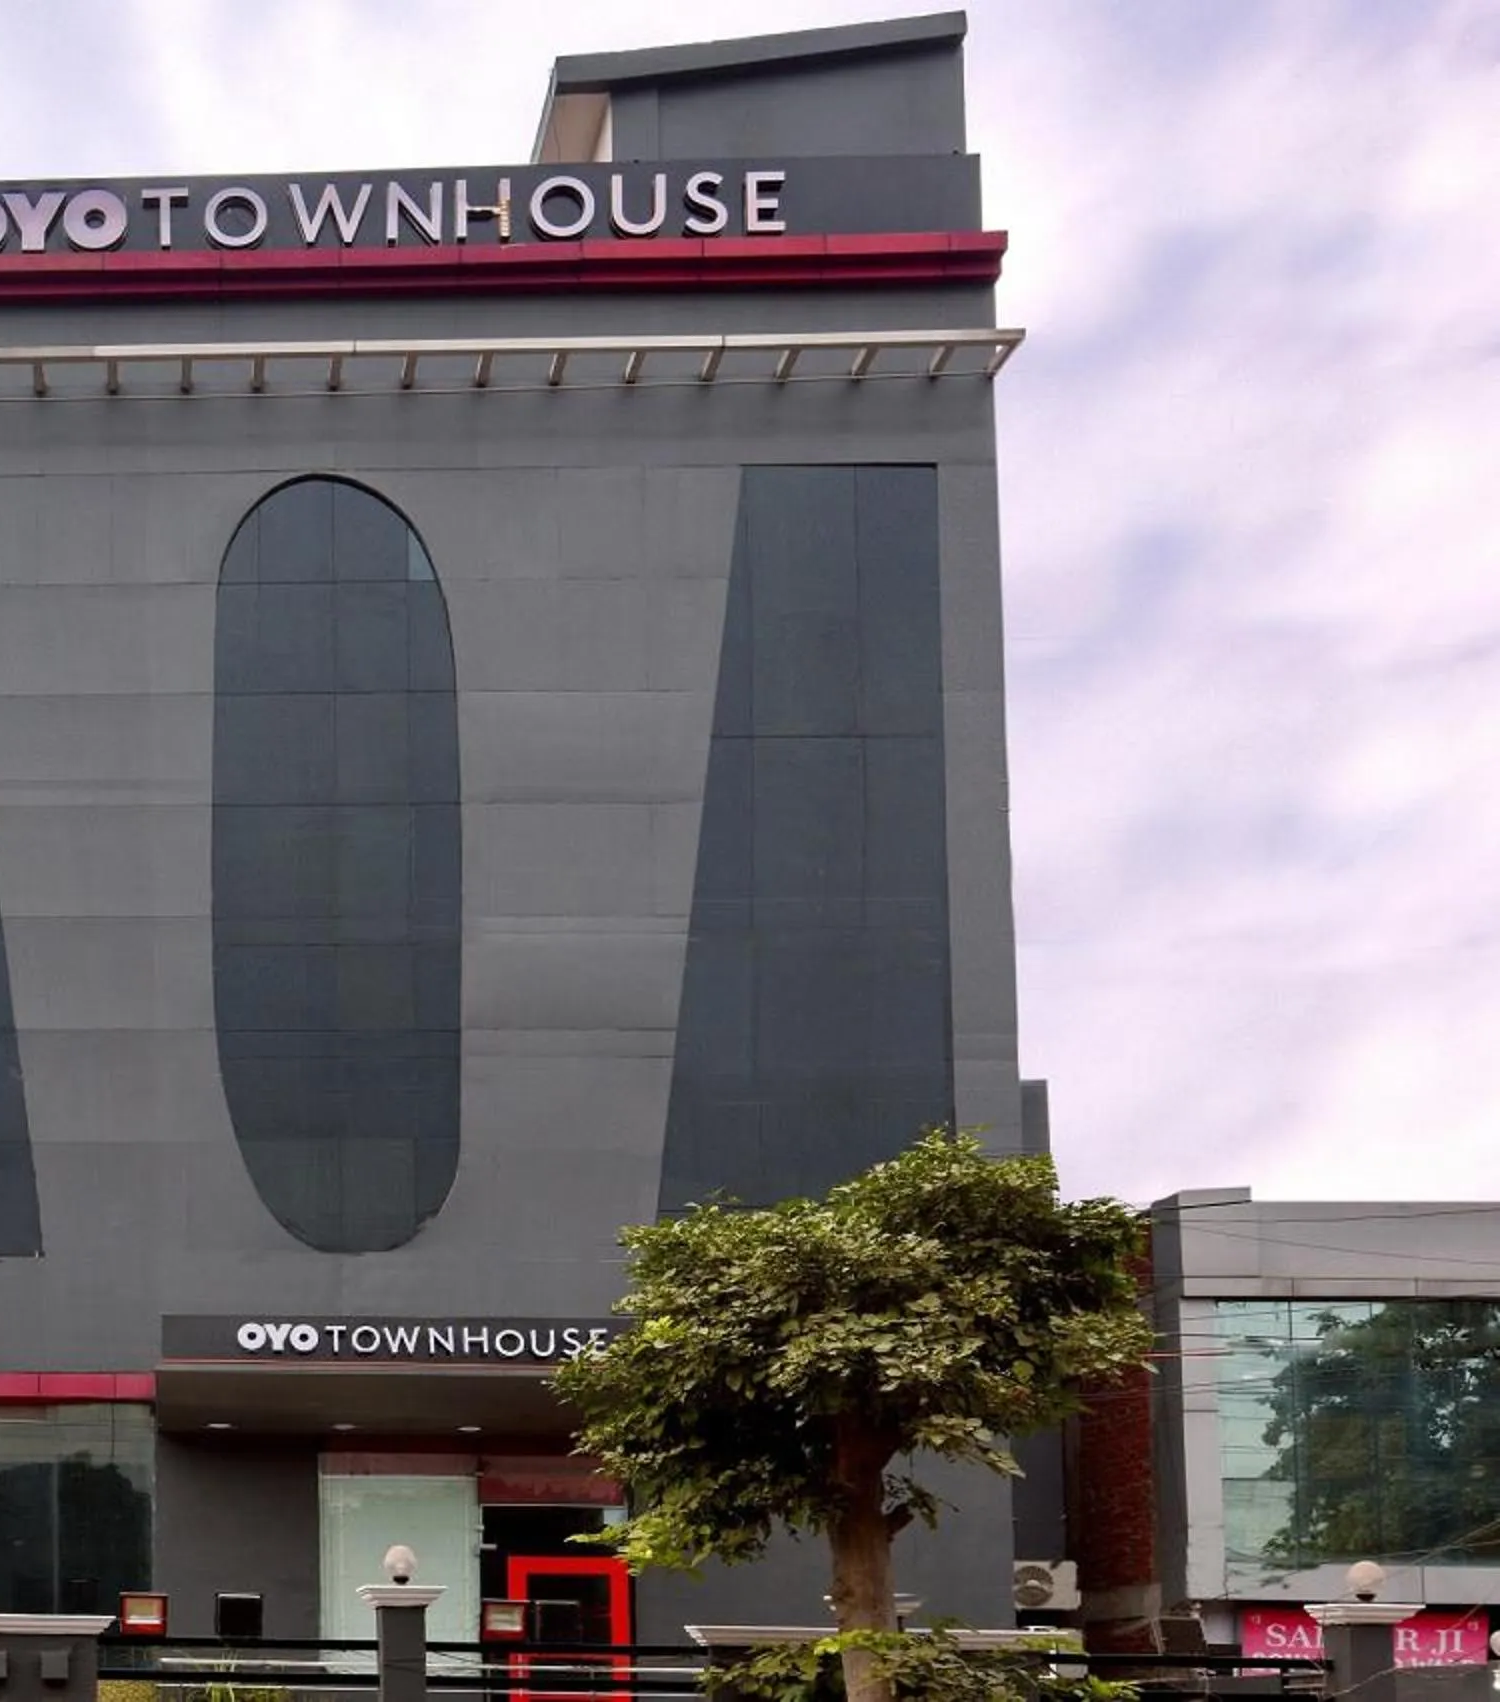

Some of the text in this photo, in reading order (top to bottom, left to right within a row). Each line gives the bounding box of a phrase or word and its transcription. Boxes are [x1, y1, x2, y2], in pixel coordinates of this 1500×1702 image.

[140, 171, 788, 251] TOWNHOUSE
[237, 1322, 610, 1358] OYO TOWNHOUSE
